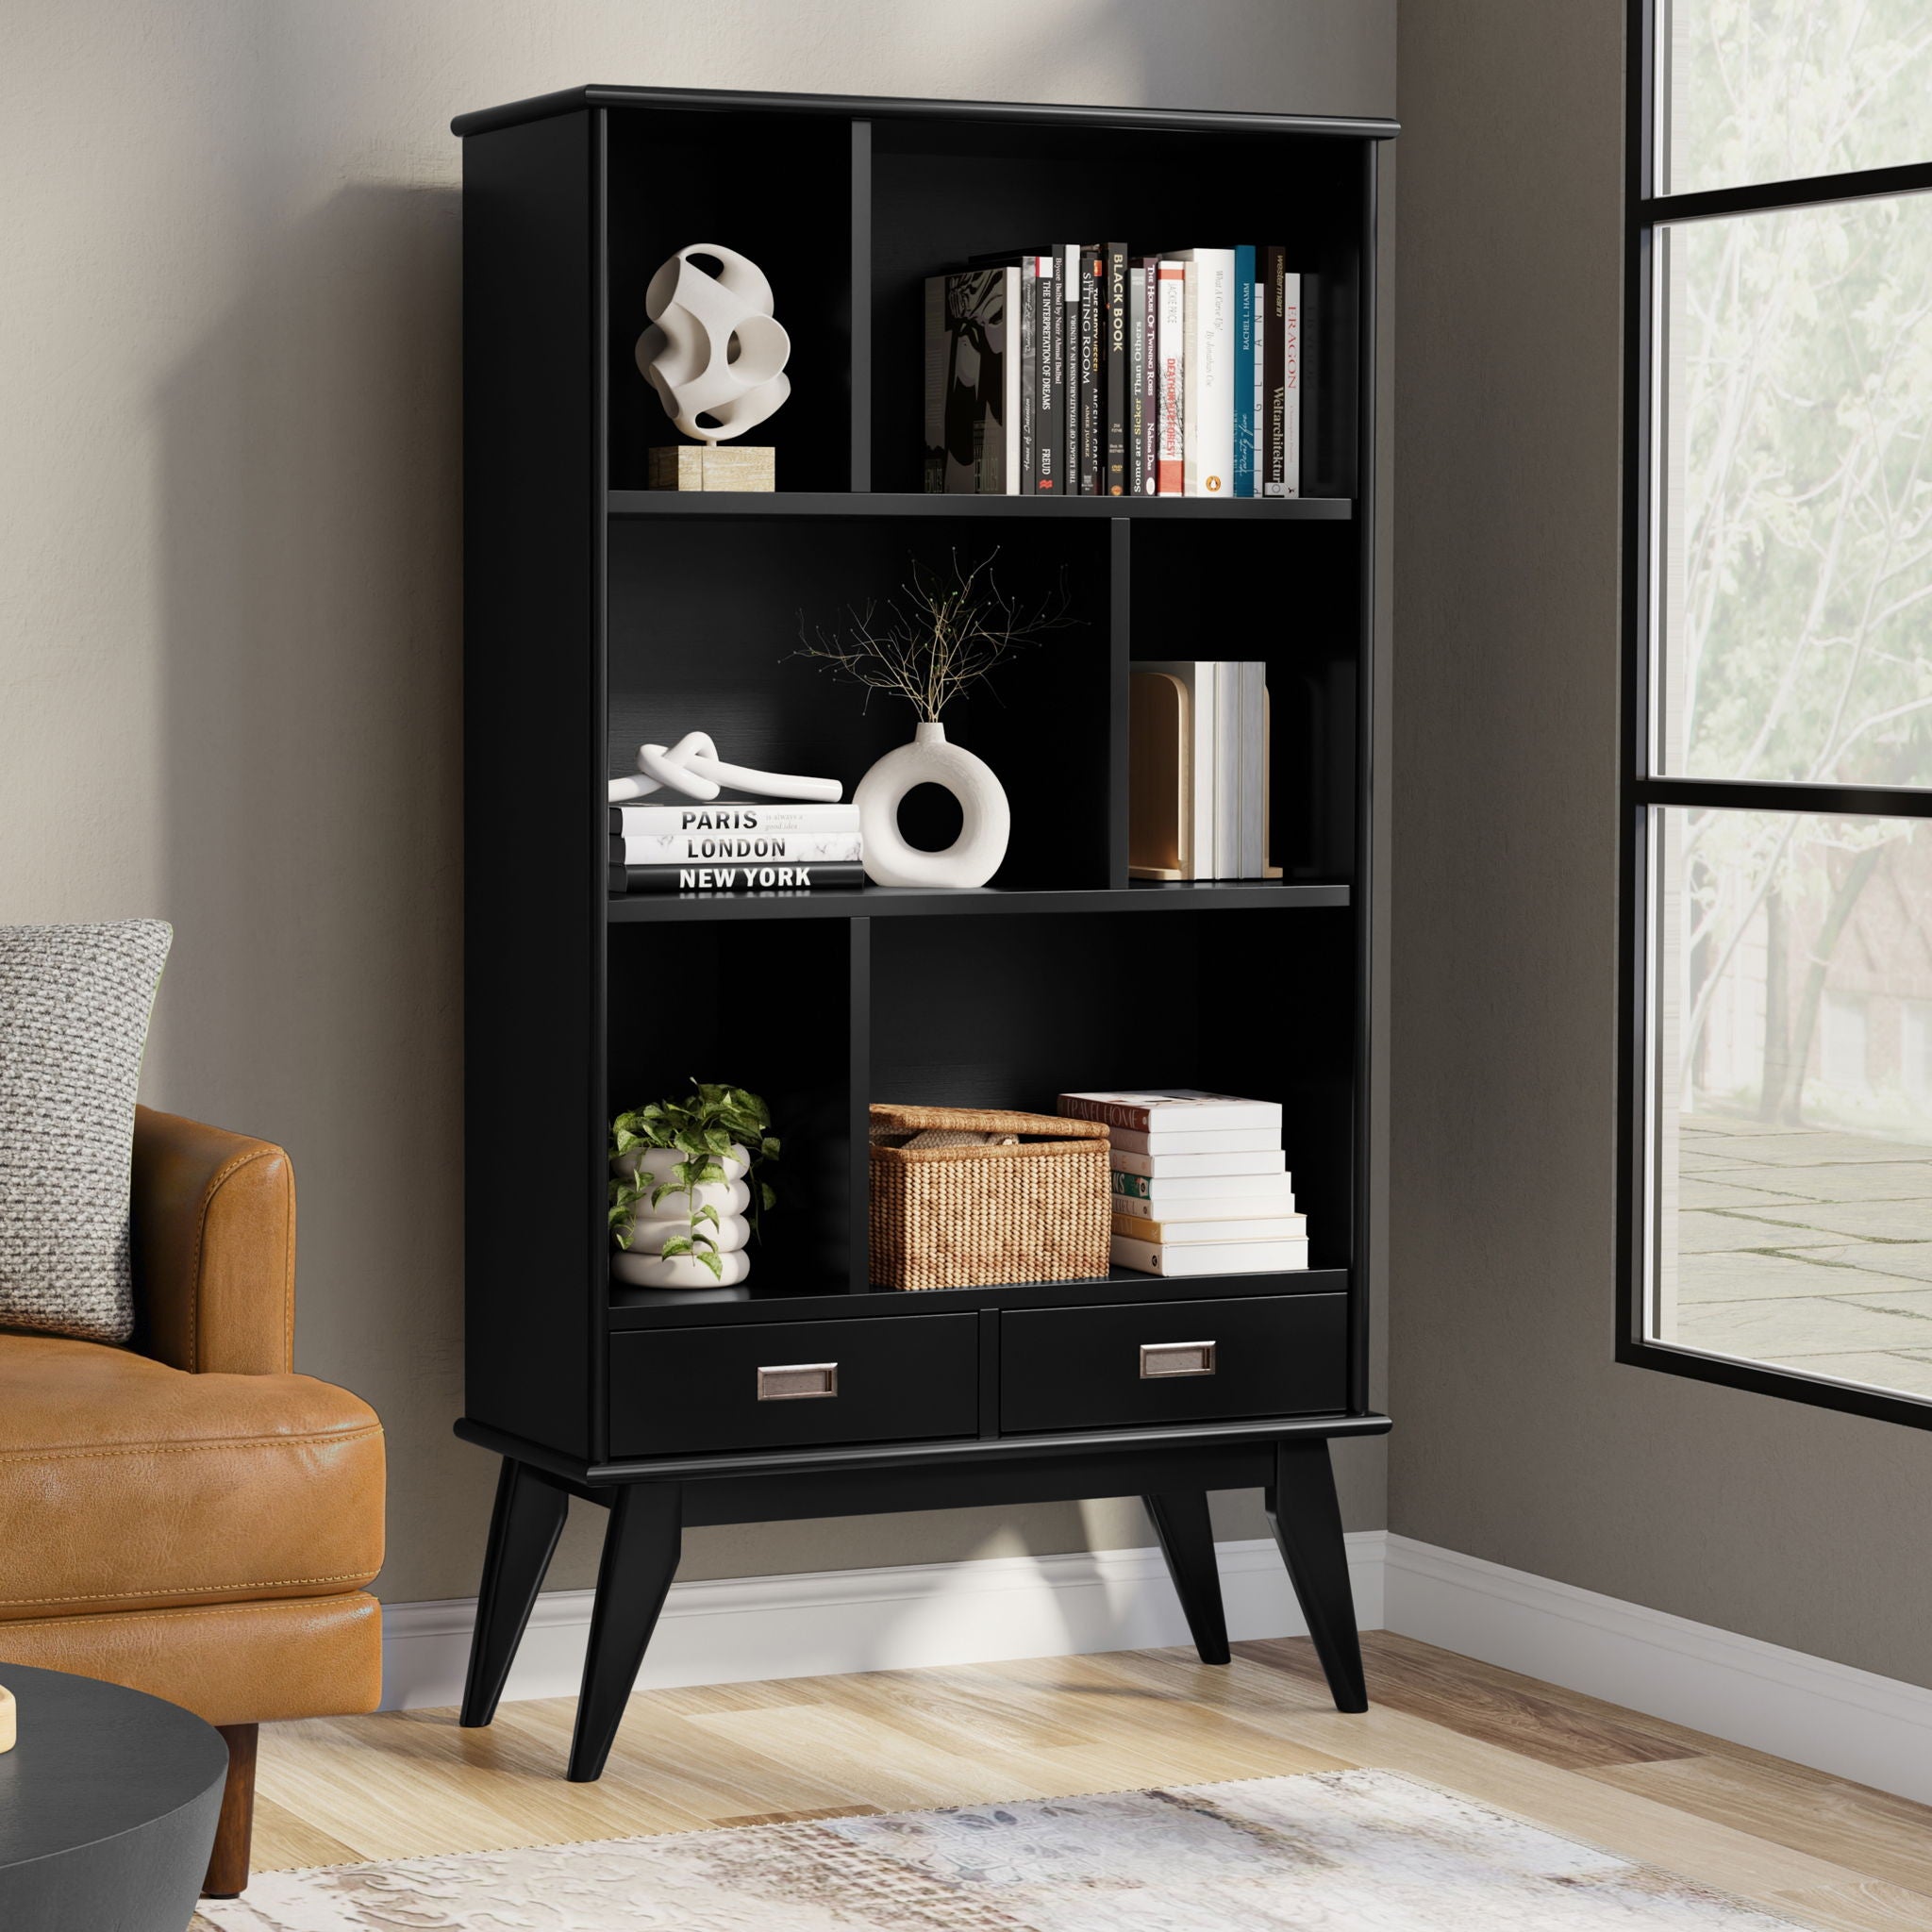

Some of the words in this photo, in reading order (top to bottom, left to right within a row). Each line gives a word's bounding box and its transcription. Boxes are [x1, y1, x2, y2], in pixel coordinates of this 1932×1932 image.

[1041, 281, 1051, 297] THE
[1113, 254, 1123, 304] BLACK
[1275, 255, 1285, 317] westermann
[1082, 272, 1091, 332] SITTING
[1168, 283, 1177, 306] JACKIE
[1055, 307, 1062, 315] by
[1168, 306, 1177, 325] PRICE
[1041, 298, 1051, 364] INTERPRETATION
[1113, 308, 1123, 352] BOOK
[1213, 317, 1223, 331] Up!
[1070, 353, 1076, 361] IN
[1288, 306, 1297, 389] ERAGON
[1041, 364, 1051, 377] OF
[1082, 336, 1091, 384] ROOM
[1167, 358, 1175, 389] DEATH
[1041, 377, 1051, 410] DREAMS
[1024, 436, 1032, 444] of
[1070, 428, 1076, 439] OF
[1236, 413, 1253, 476] twenty-five
[1273, 387, 1284, 483] Weltarchitektur
[1041, 449, 1051, 475] FREUD
[682, 810, 758, 830] PARIS
[688, 838, 786, 858] LONDON
[679, 869, 736, 889] NEW
[743, 867, 811, 888] YORK
[1104, 1104, 1138, 1128] HOME
